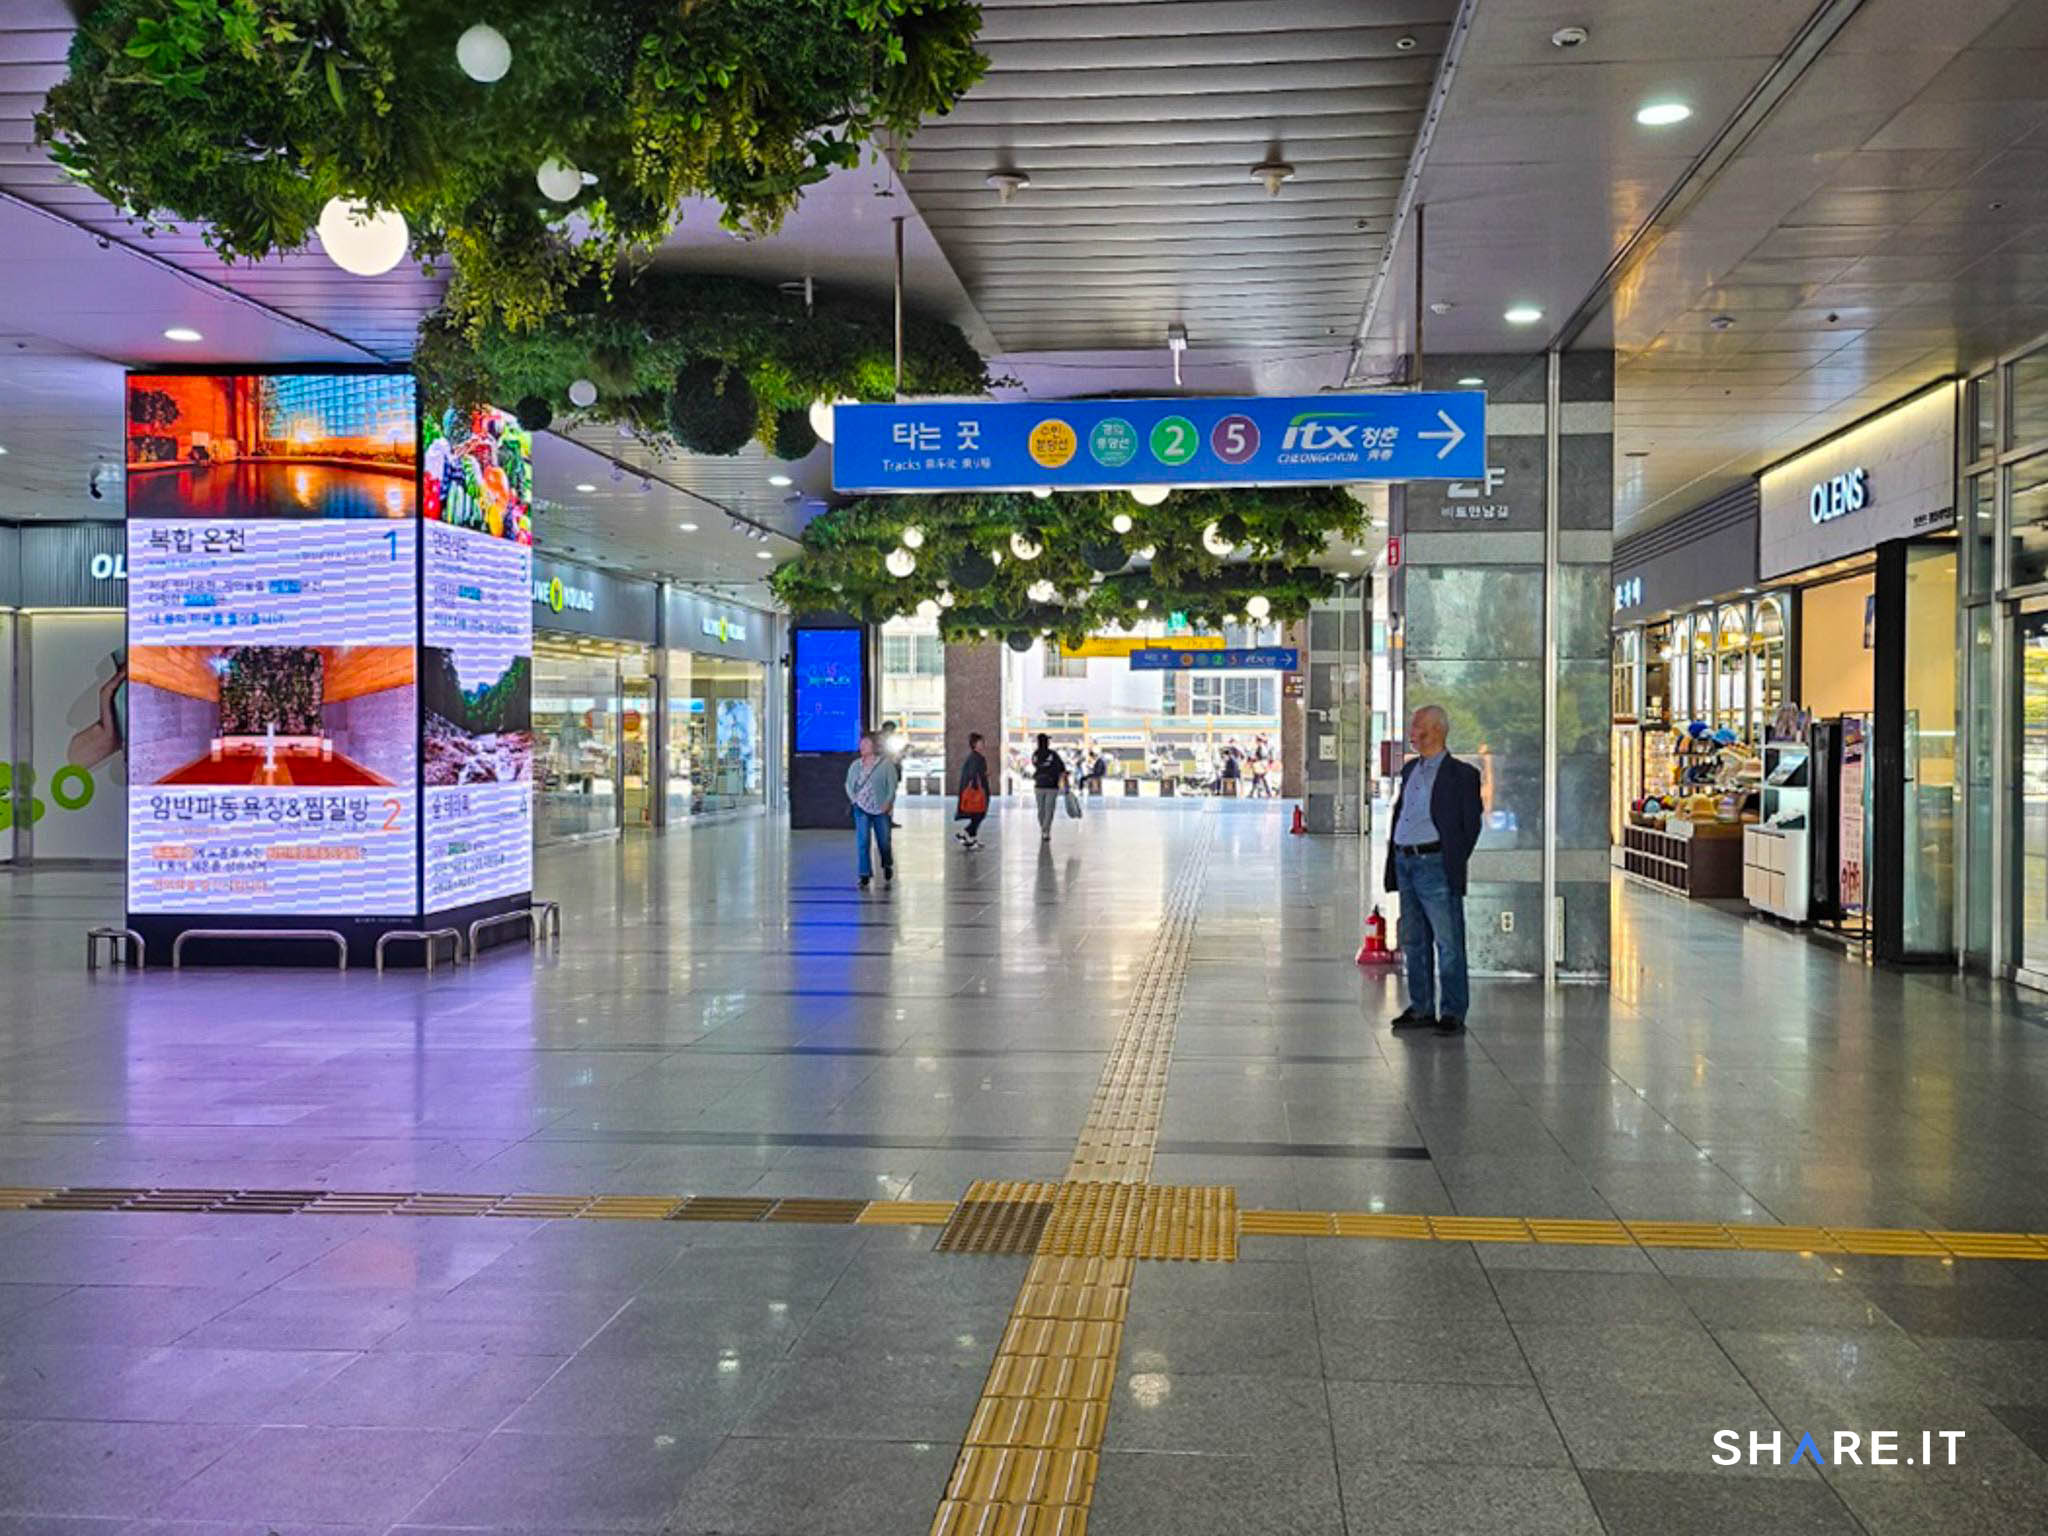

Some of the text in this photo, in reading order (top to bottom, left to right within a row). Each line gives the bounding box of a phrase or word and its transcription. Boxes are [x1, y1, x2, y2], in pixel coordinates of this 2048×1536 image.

[892, 420, 981, 451] 타는 곳
[1165, 425, 1185, 455] 2
[1225, 424, 1246, 455] 5
[1360, 425, 1400, 449] 청춘
[881, 458, 921, 472] Tracks
[1810, 466, 1866, 525] OLENS
[149, 527, 247, 553] 복합 온천
[382, 530, 398, 562] 1
[149, 796, 371, 822] 암반파동욕장&찜질방
[382, 798, 402, 831] 2
